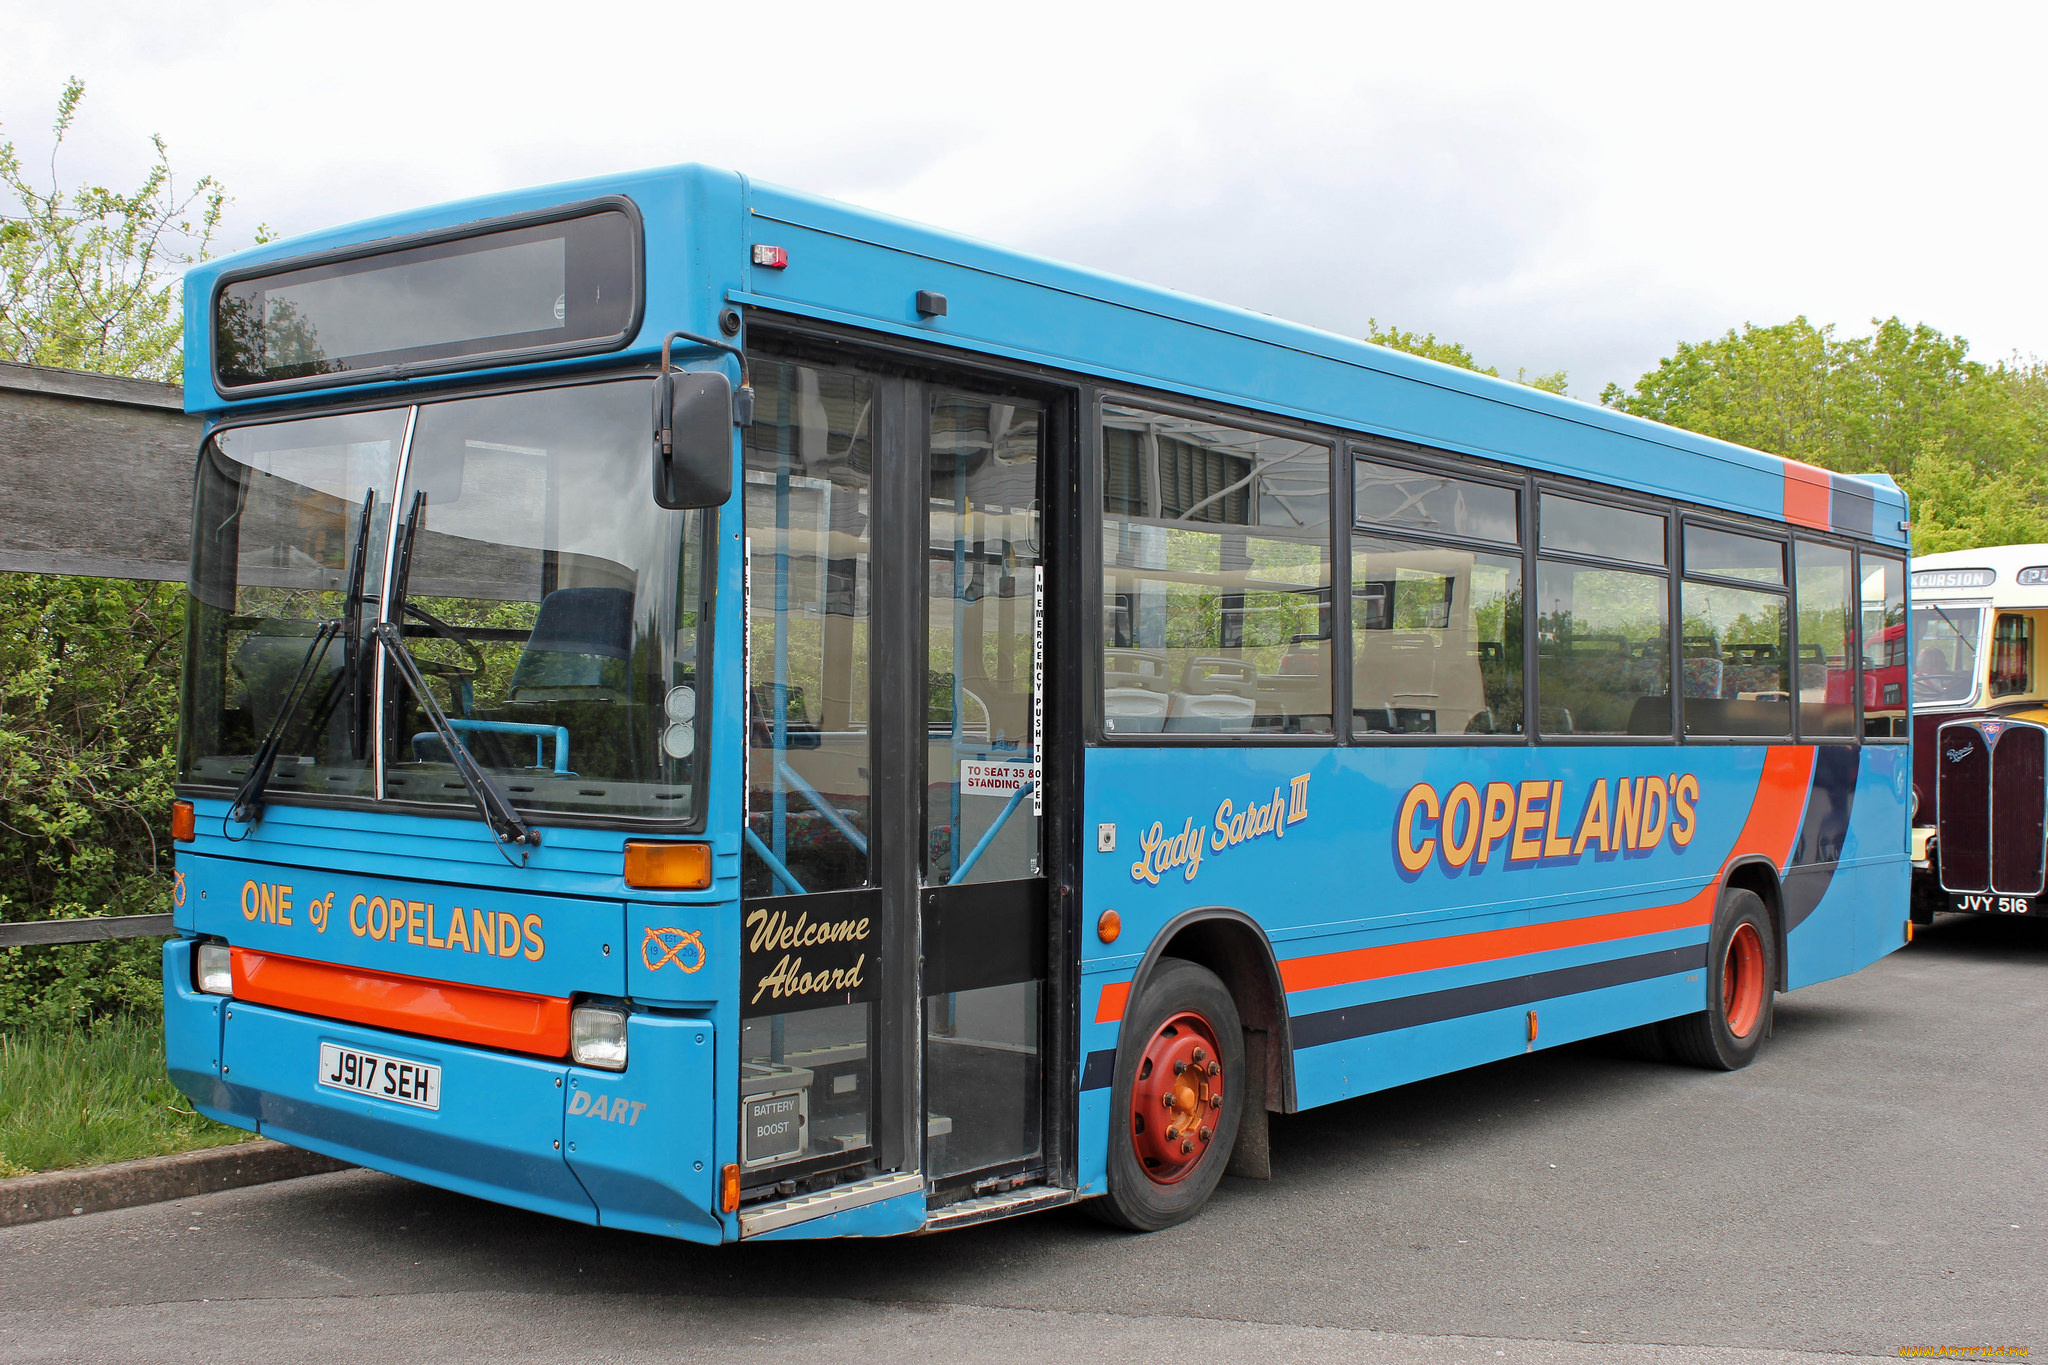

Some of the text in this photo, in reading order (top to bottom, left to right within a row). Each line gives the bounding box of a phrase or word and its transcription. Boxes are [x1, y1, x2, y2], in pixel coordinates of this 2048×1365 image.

[1036, 573, 1043, 593] IN
[1035, 599, 1044, 692] EMERGENCY
[1035, 744, 1041, 764] TO
[967, 766, 981, 776] TO
[984, 767, 1010, 777] SEAT
[1012, 768, 1025, 778] 35
[967, 777, 1020, 789] STANDING
[1130, 772, 1311, 886] Lady Sarah III
[1396, 772, 1699, 880] COPELAND'S
[1956, 895, 2029, 914] JVY 516
[240, 879, 546, 962] ONE of COPELANDS
[745, 908, 871, 953] Welcome
[650, 946, 658, 956] 19
[751, 953, 865, 1005] Aboard
[330, 1051, 429, 1102] J917 SEH
[567, 1090, 647, 1127] DART
[754, 1100, 795, 1117] BATTERY
[757, 1121, 790, 1137] BOOST
